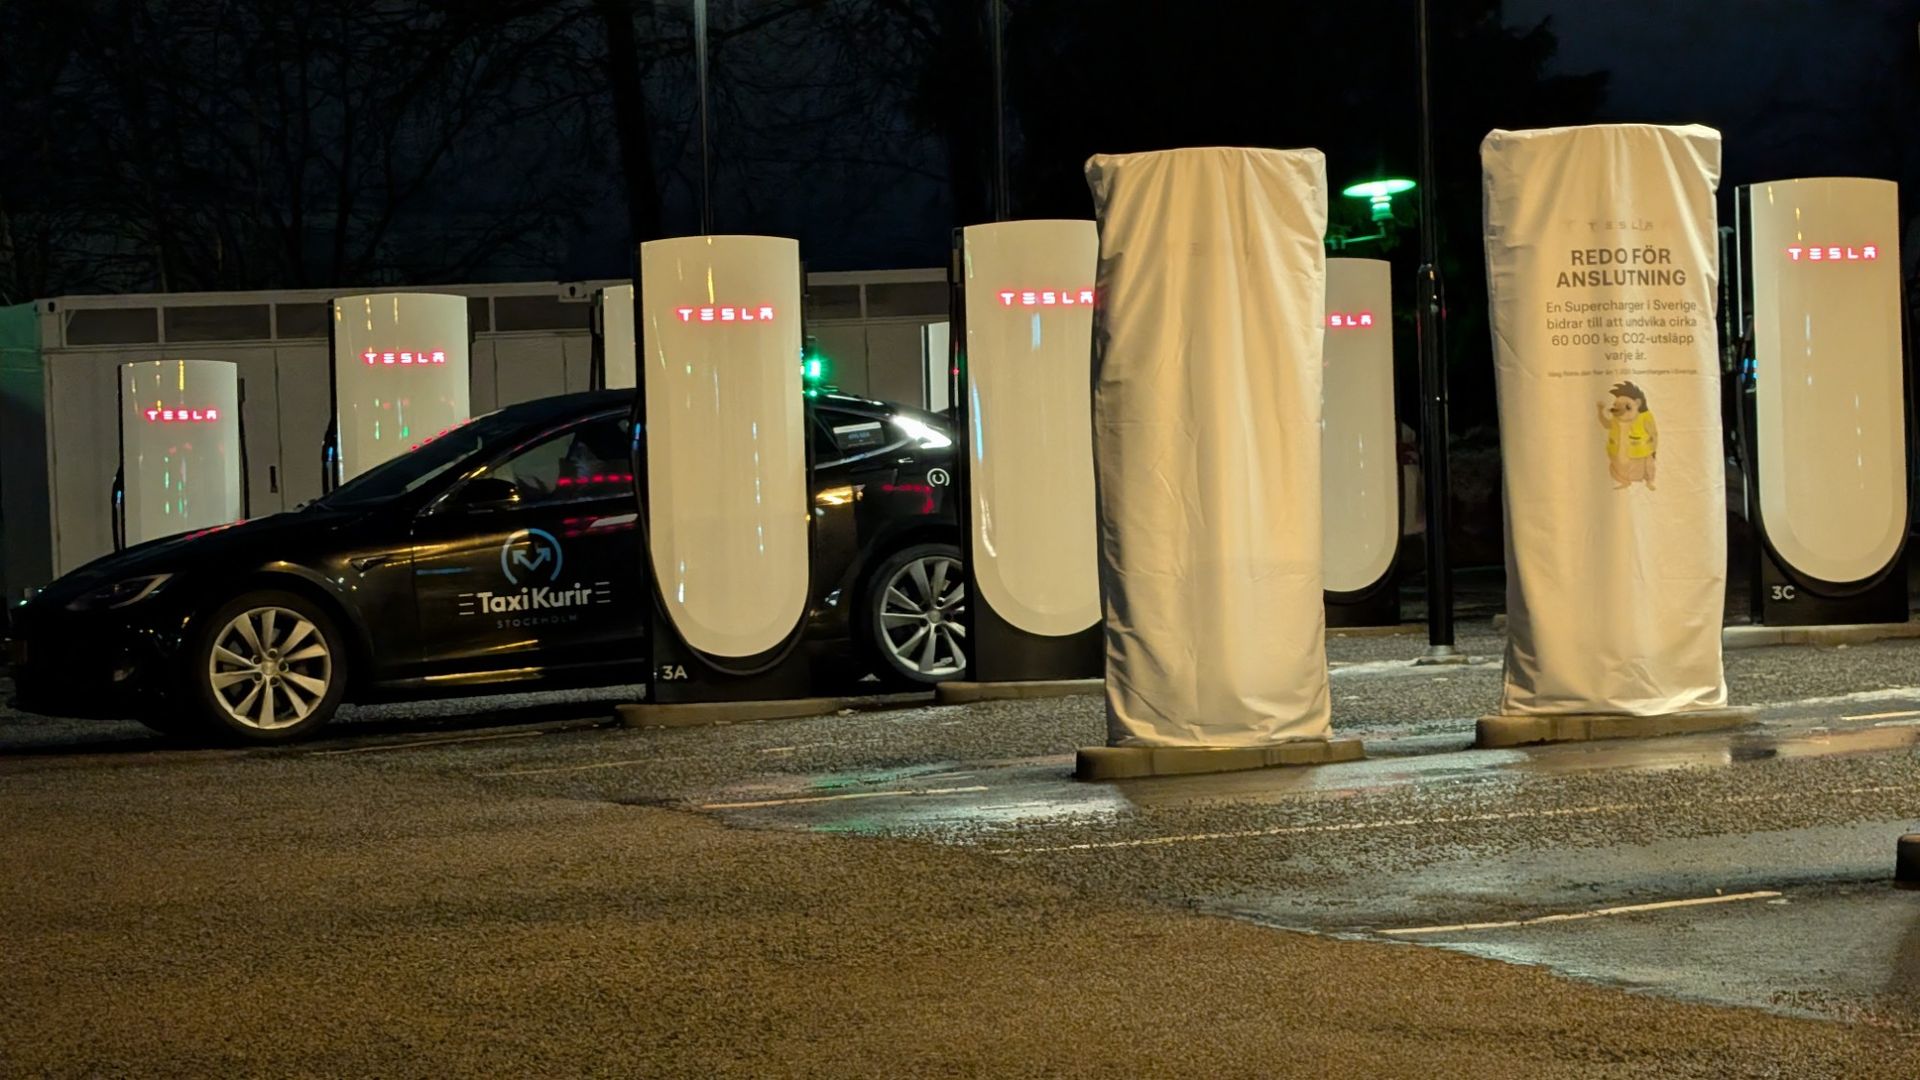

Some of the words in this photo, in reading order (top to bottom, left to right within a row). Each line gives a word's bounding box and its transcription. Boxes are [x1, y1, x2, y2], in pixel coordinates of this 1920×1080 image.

[1571, 247, 1628, 266] REDO
[1631, 244, 1672, 265] FÖR
[1787, 245, 1877, 261] TESLA
[1556, 269, 1687, 288] ANSLUTNING
[1000, 290, 1094, 306] TESLA
[1546, 301, 1562, 313] En
[1564, 300, 1644, 314] Supercharger
[1652, 299, 1697, 313] Sverige
[677, 306, 774, 323] TESLA
[1546, 318, 1583, 330] bidrar
[1587, 317, 1603, 329] till
[1606, 317, 1623, 328] att
[1625, 317, 1666, 328] undvika
[1668, 316, 1698, 328] cirka
[1551, 334, 1569, 346] 60
[1572, 333, 1600, 346] 000
[1603, 333, 1619, 346] kg
[363, 351, 445, 365] TESLA
[1604, 350, 1633, 363] varje
[1634, 348, 1647, 361] år.
[146, 409, 218, 421] TESLA
[1771, 585, 1796, 600] 3C
[496, 614, 577, 629] STOCKHOLM
[662, 664, 689, 680] 3A
